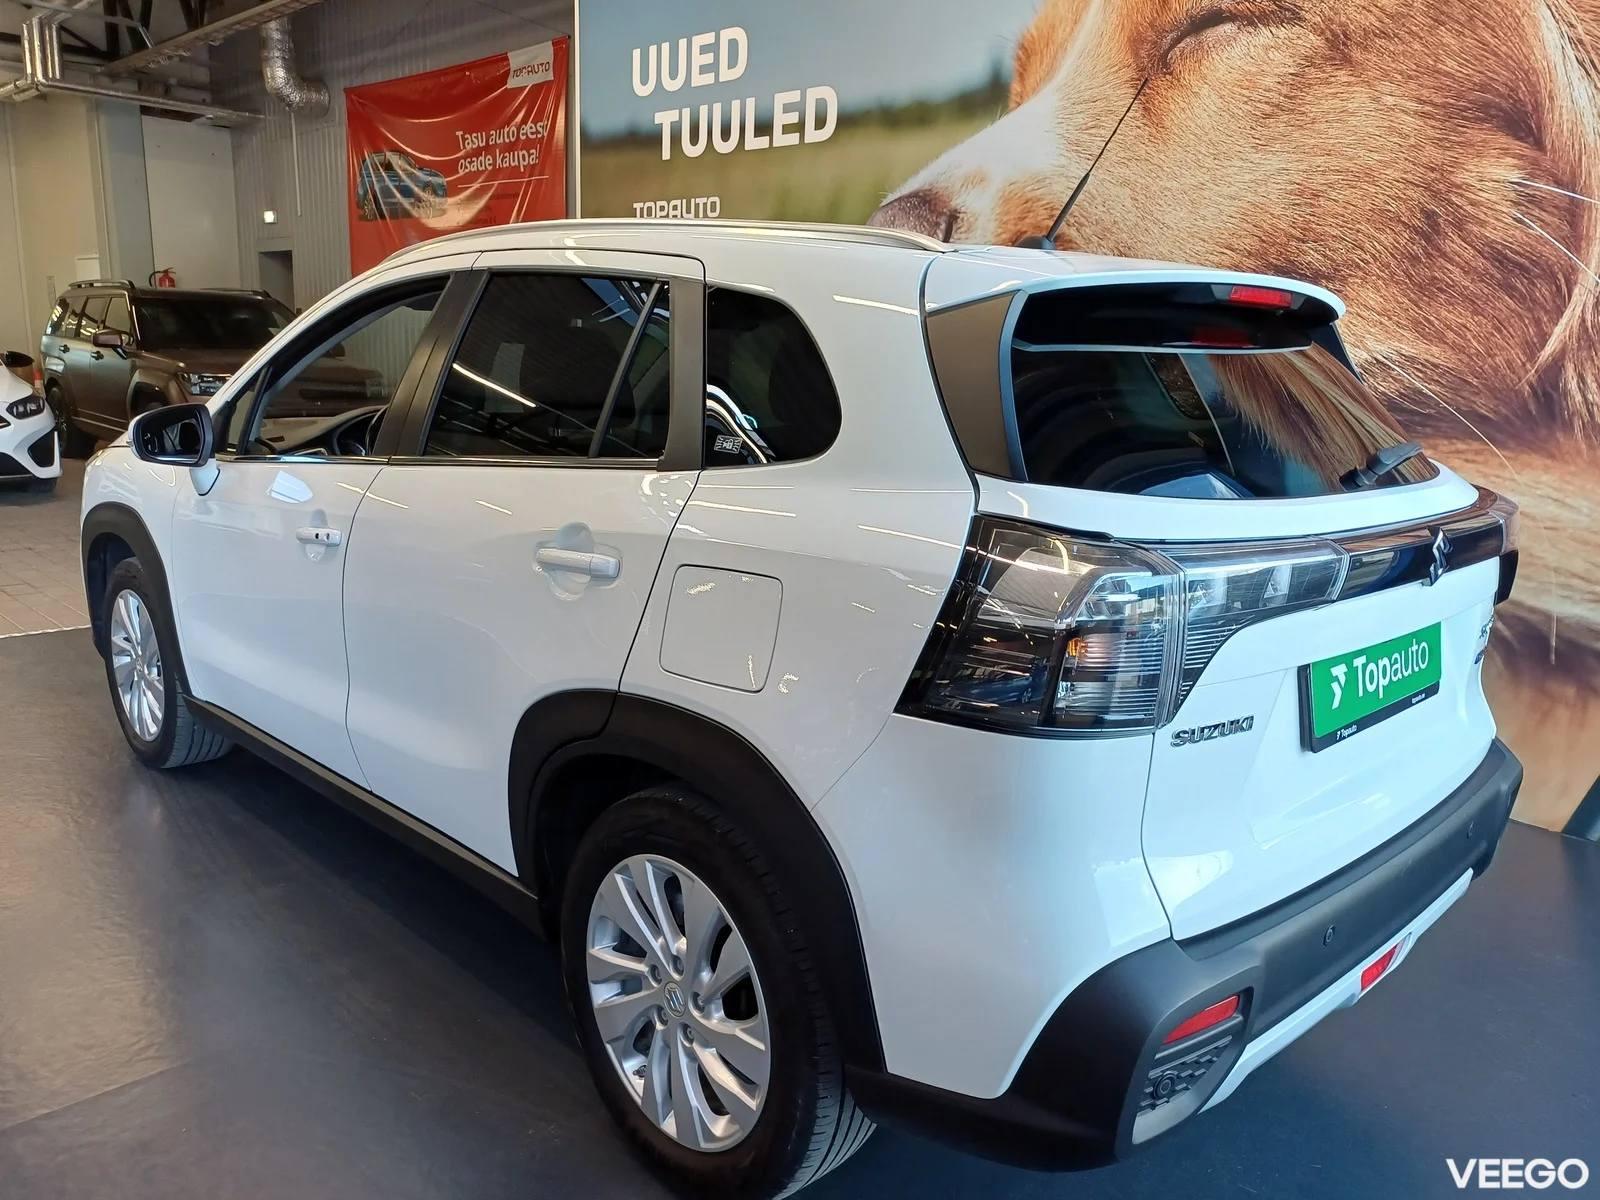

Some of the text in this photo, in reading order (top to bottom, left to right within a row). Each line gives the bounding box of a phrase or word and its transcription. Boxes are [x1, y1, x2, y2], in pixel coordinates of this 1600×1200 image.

[632, 26, 748, 97] UUED
[455, 120, 548, 150] Tasu auto eest
[654, 85, 838, 161] TUULED
[457, 143, 540, 174] osade kaupa!
[632, 196, 721, 219] TOPAUTO
[1353, 637, 1429, 699] Topauto
[1170, 715, 1254, 748] SUZUKI
